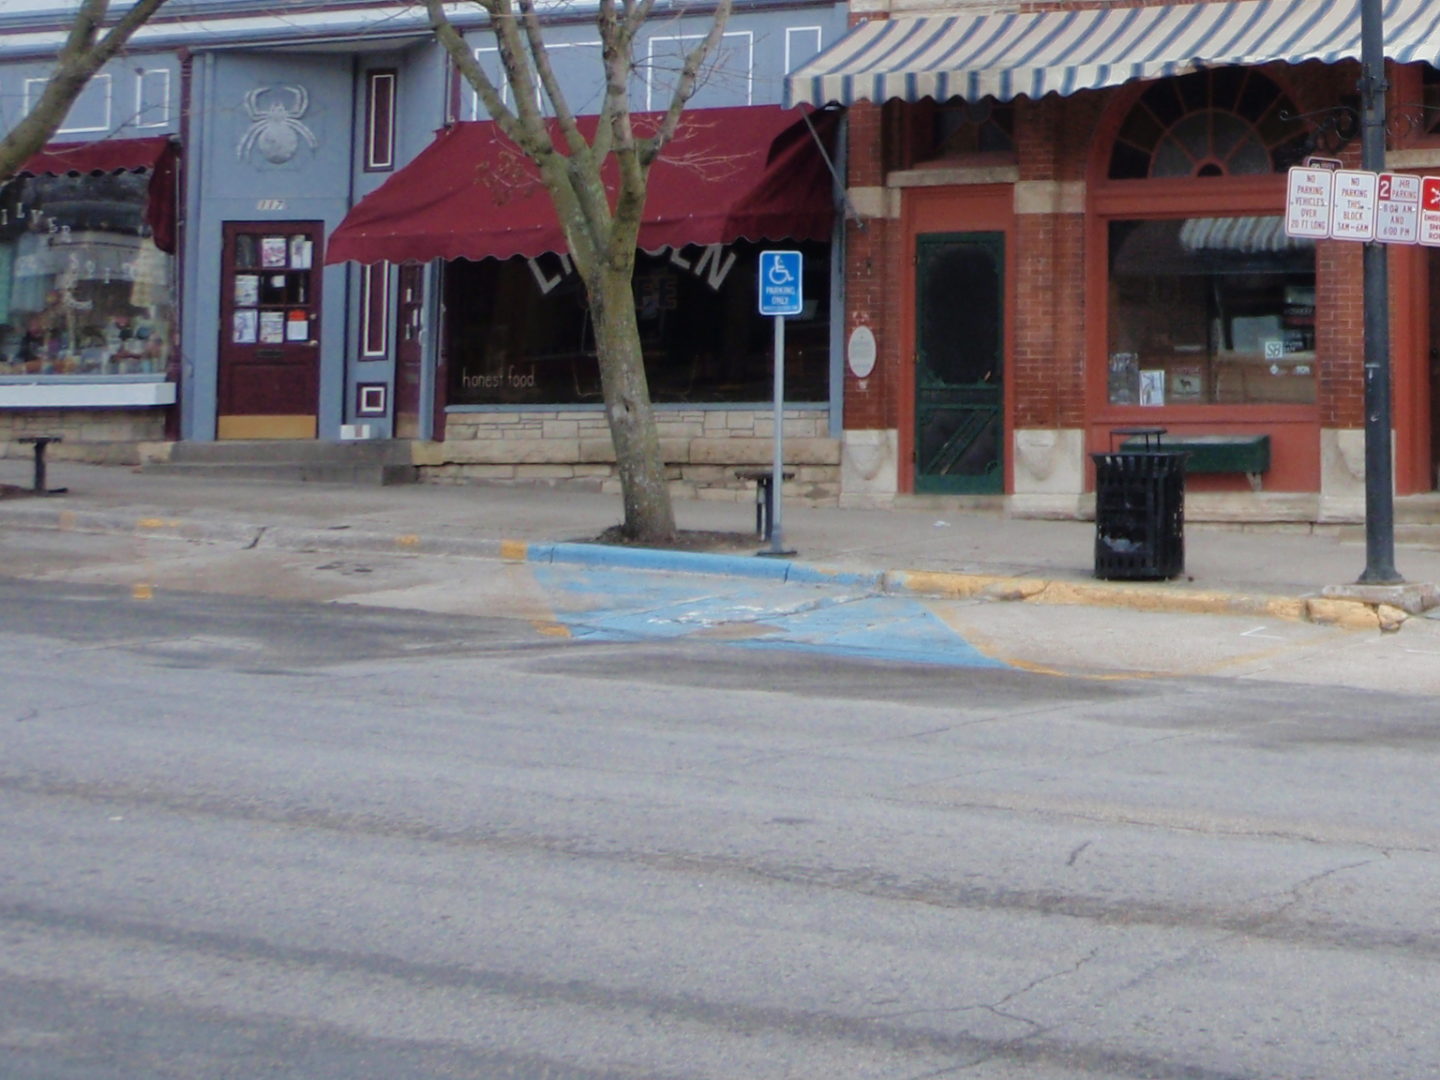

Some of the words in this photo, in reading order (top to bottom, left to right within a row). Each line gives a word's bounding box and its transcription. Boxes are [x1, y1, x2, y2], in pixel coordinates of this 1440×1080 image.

[1306, 174, 1316, 183] NO
[1351, 177, 1360, 186] NO
[1297, 185, 1324, 195] PARKING
[1379, 180, 1390, 197] 2
[1399, 179, 1410, 188] HR
[1341, 188, 1368, 198] PARKING
[1392, 190, 1417, 199] PARKING
[1295, 197, 1325, 207] VEHICLES
[1300, 208, 1317, 217] OVER
[1403, 205, 1412, 213] AM
[1343, 211, 1363, 220] BLOCK
[1291, 219, 1299, 228] 20
[1301, 220, 1308, 229] FT
[1310, 221, 1326, 230] LONG
[1390, 216, 1404, 225] AND
[1400, 227, 1410, 236] PM
[462, 367, 504, 388] honest
[508, 364, 535, 388] food
